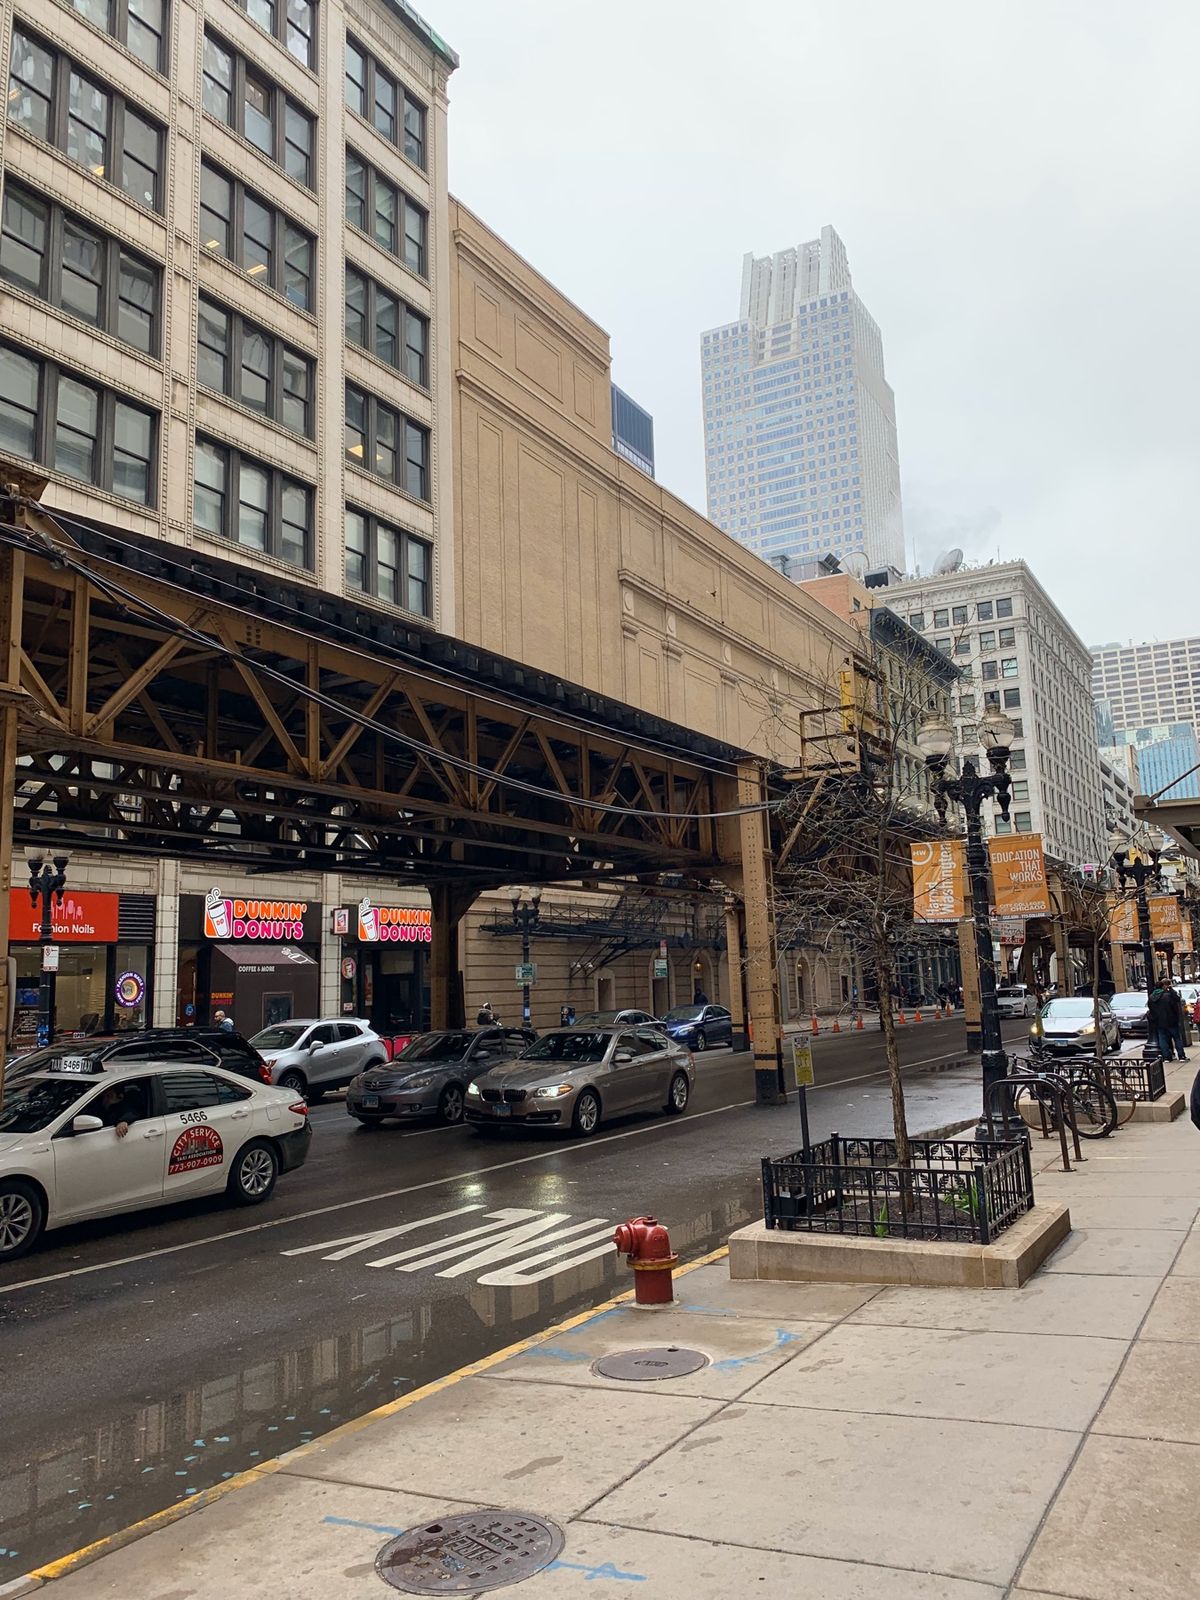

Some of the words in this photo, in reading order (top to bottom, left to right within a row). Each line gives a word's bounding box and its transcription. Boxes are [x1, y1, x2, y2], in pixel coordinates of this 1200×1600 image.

[991, 849, 1040, 864] EDUCATION
[1020, 860, 1041, 872] THAT
[1010, 870, 1043, 883] WORKS
[233, 900, 307, 921] DUNKIN'
[72, 924, 95, 934] Nails
[233, 920, 304, 940] DONUTS
[380, 925, 432, 943] DONUTS
[63, 1060, 80, 1070] 5466
[180, 1111, 208, 1124] 5466
[173, 1136, 188, 1157] CITY
[190, 1128, 220, 1148] SERVICE
[169, 1155, 222, 1173] 773-907-0909
